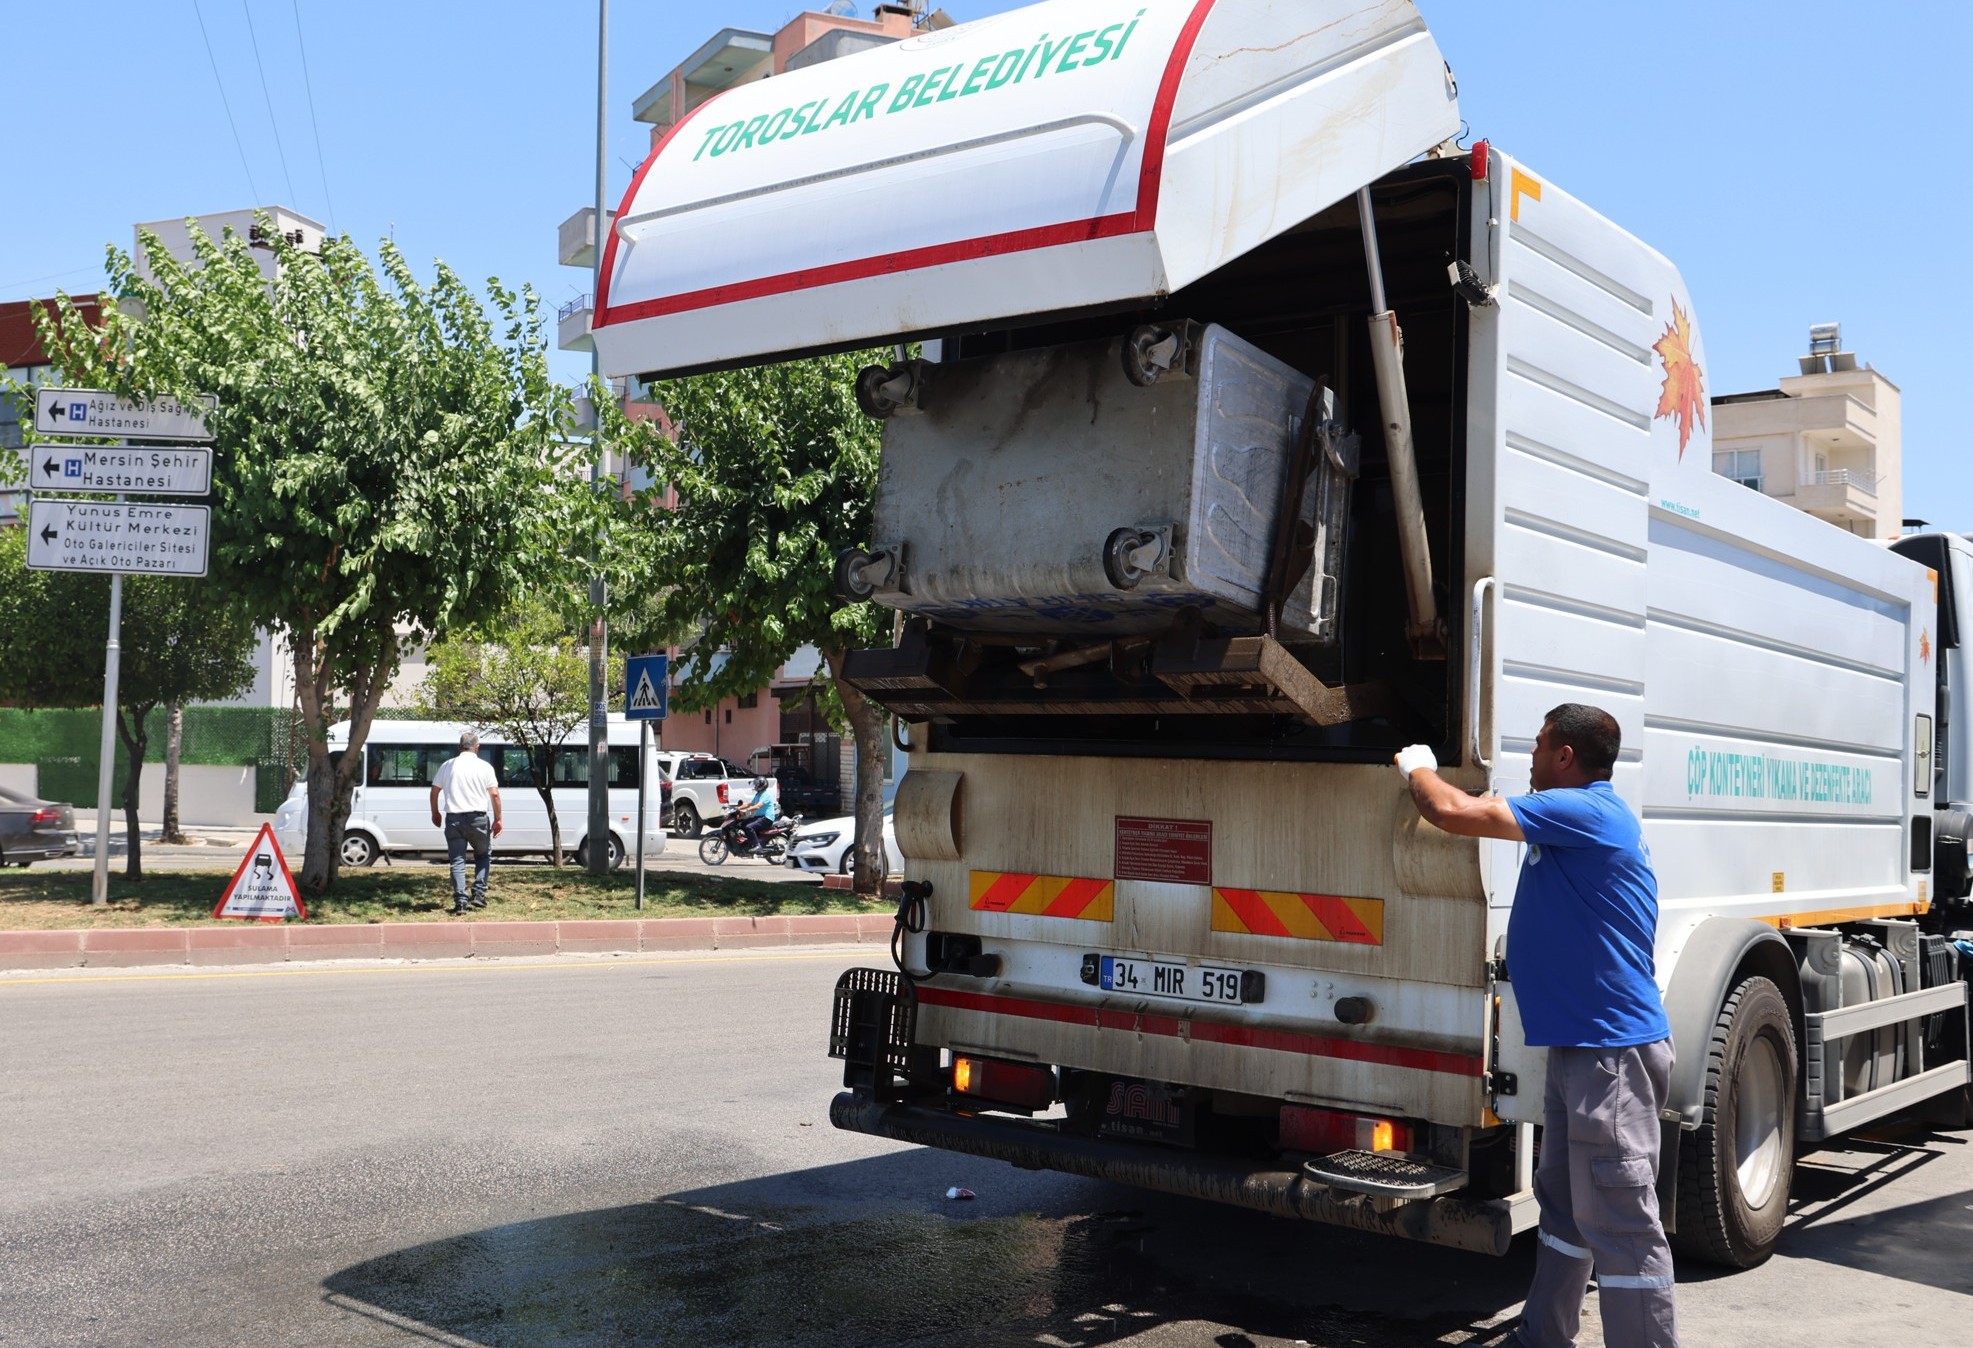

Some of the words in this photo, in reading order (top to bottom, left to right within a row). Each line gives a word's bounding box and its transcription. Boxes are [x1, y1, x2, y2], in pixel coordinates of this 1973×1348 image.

[693, 83, 889, 161] TOROSLAR
[886, 8, 1147, 114] BELEDİYESİ
[89, 399, 116, 413] Ağız
[120, 404, 133, 412] ve
[138, 401, 156, 413] Diş
[88, 415, 149, 428] Hastanesi
[84, 452, 144, 467] Mersin
[151, 453, 199, 469] Şehir
[83, 472, 171, 487] Hastanesi
[67, 505, 121, 518] Yunus
[128, 507, 172, 520] Emre
[67, 520, 121, 533] Kültür
[128, 522, 198, 536] Merkezi
[64, 538, 84, 549] Oto
[89, 539, 156, 552] Galericiler
[160, 541, 196, 554] Sitesi
[62, 555, 77, 565] ve
[80, 554, 107, 568] Açık
[111, 555, 131, 567] Oto
[136, 556, 176, 569] Pazarı
[1688, 745, 1707, 801] ÇÖP
[1709, 752, 1765, 798] KONTEYNERİ
[233, 894, 292, 902] YAPILMAKTADIR
[1104, 975, 1113, 983] TR
[1115, 962, 1138, 988] 34
[1154, 966, 1185, 995] MIR
[1202, 971, 1238, 1000] 519
